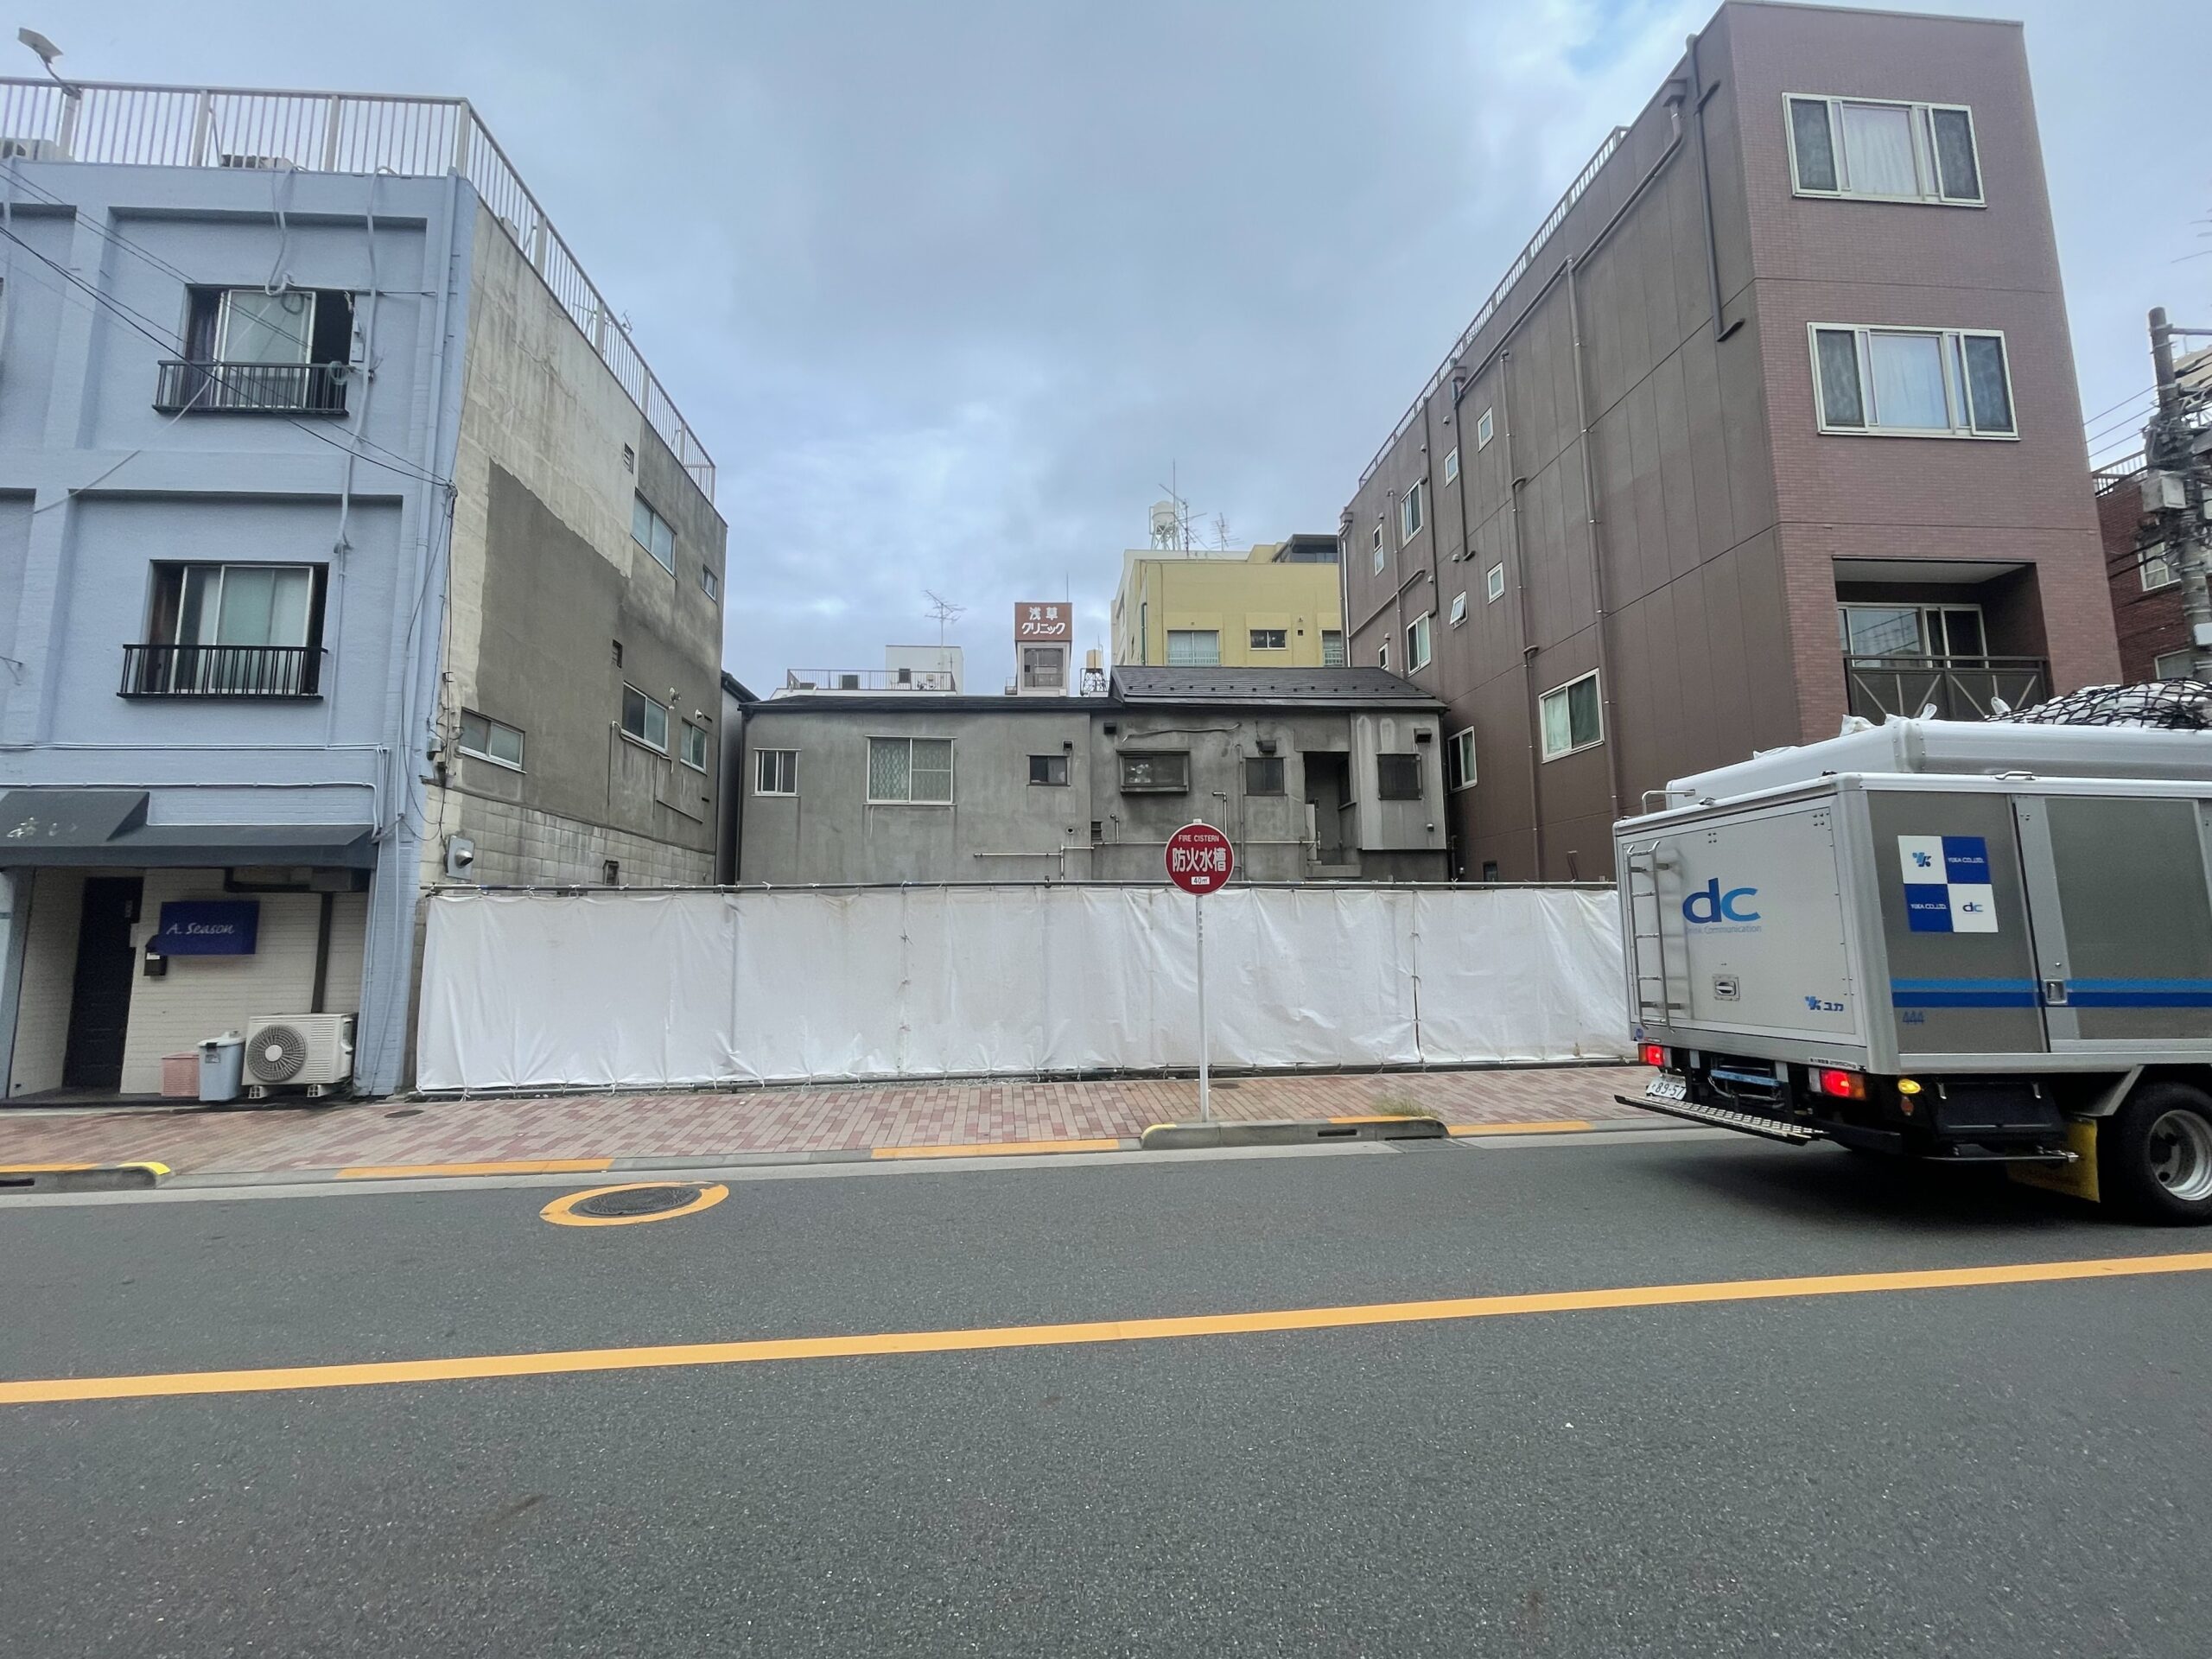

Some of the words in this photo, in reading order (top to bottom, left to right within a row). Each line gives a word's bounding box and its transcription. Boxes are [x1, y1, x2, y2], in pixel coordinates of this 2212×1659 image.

[1021, 622, 1065, 634] クリニック
[1172, 847, 1226, 872] 防火水槽
[1682, 877, 1762, 924] dc
[1962, 901, 1984, 912] dc
[186, 922, 235, 935] Season
[1655, 1082, 1687, 1096] 89-57
